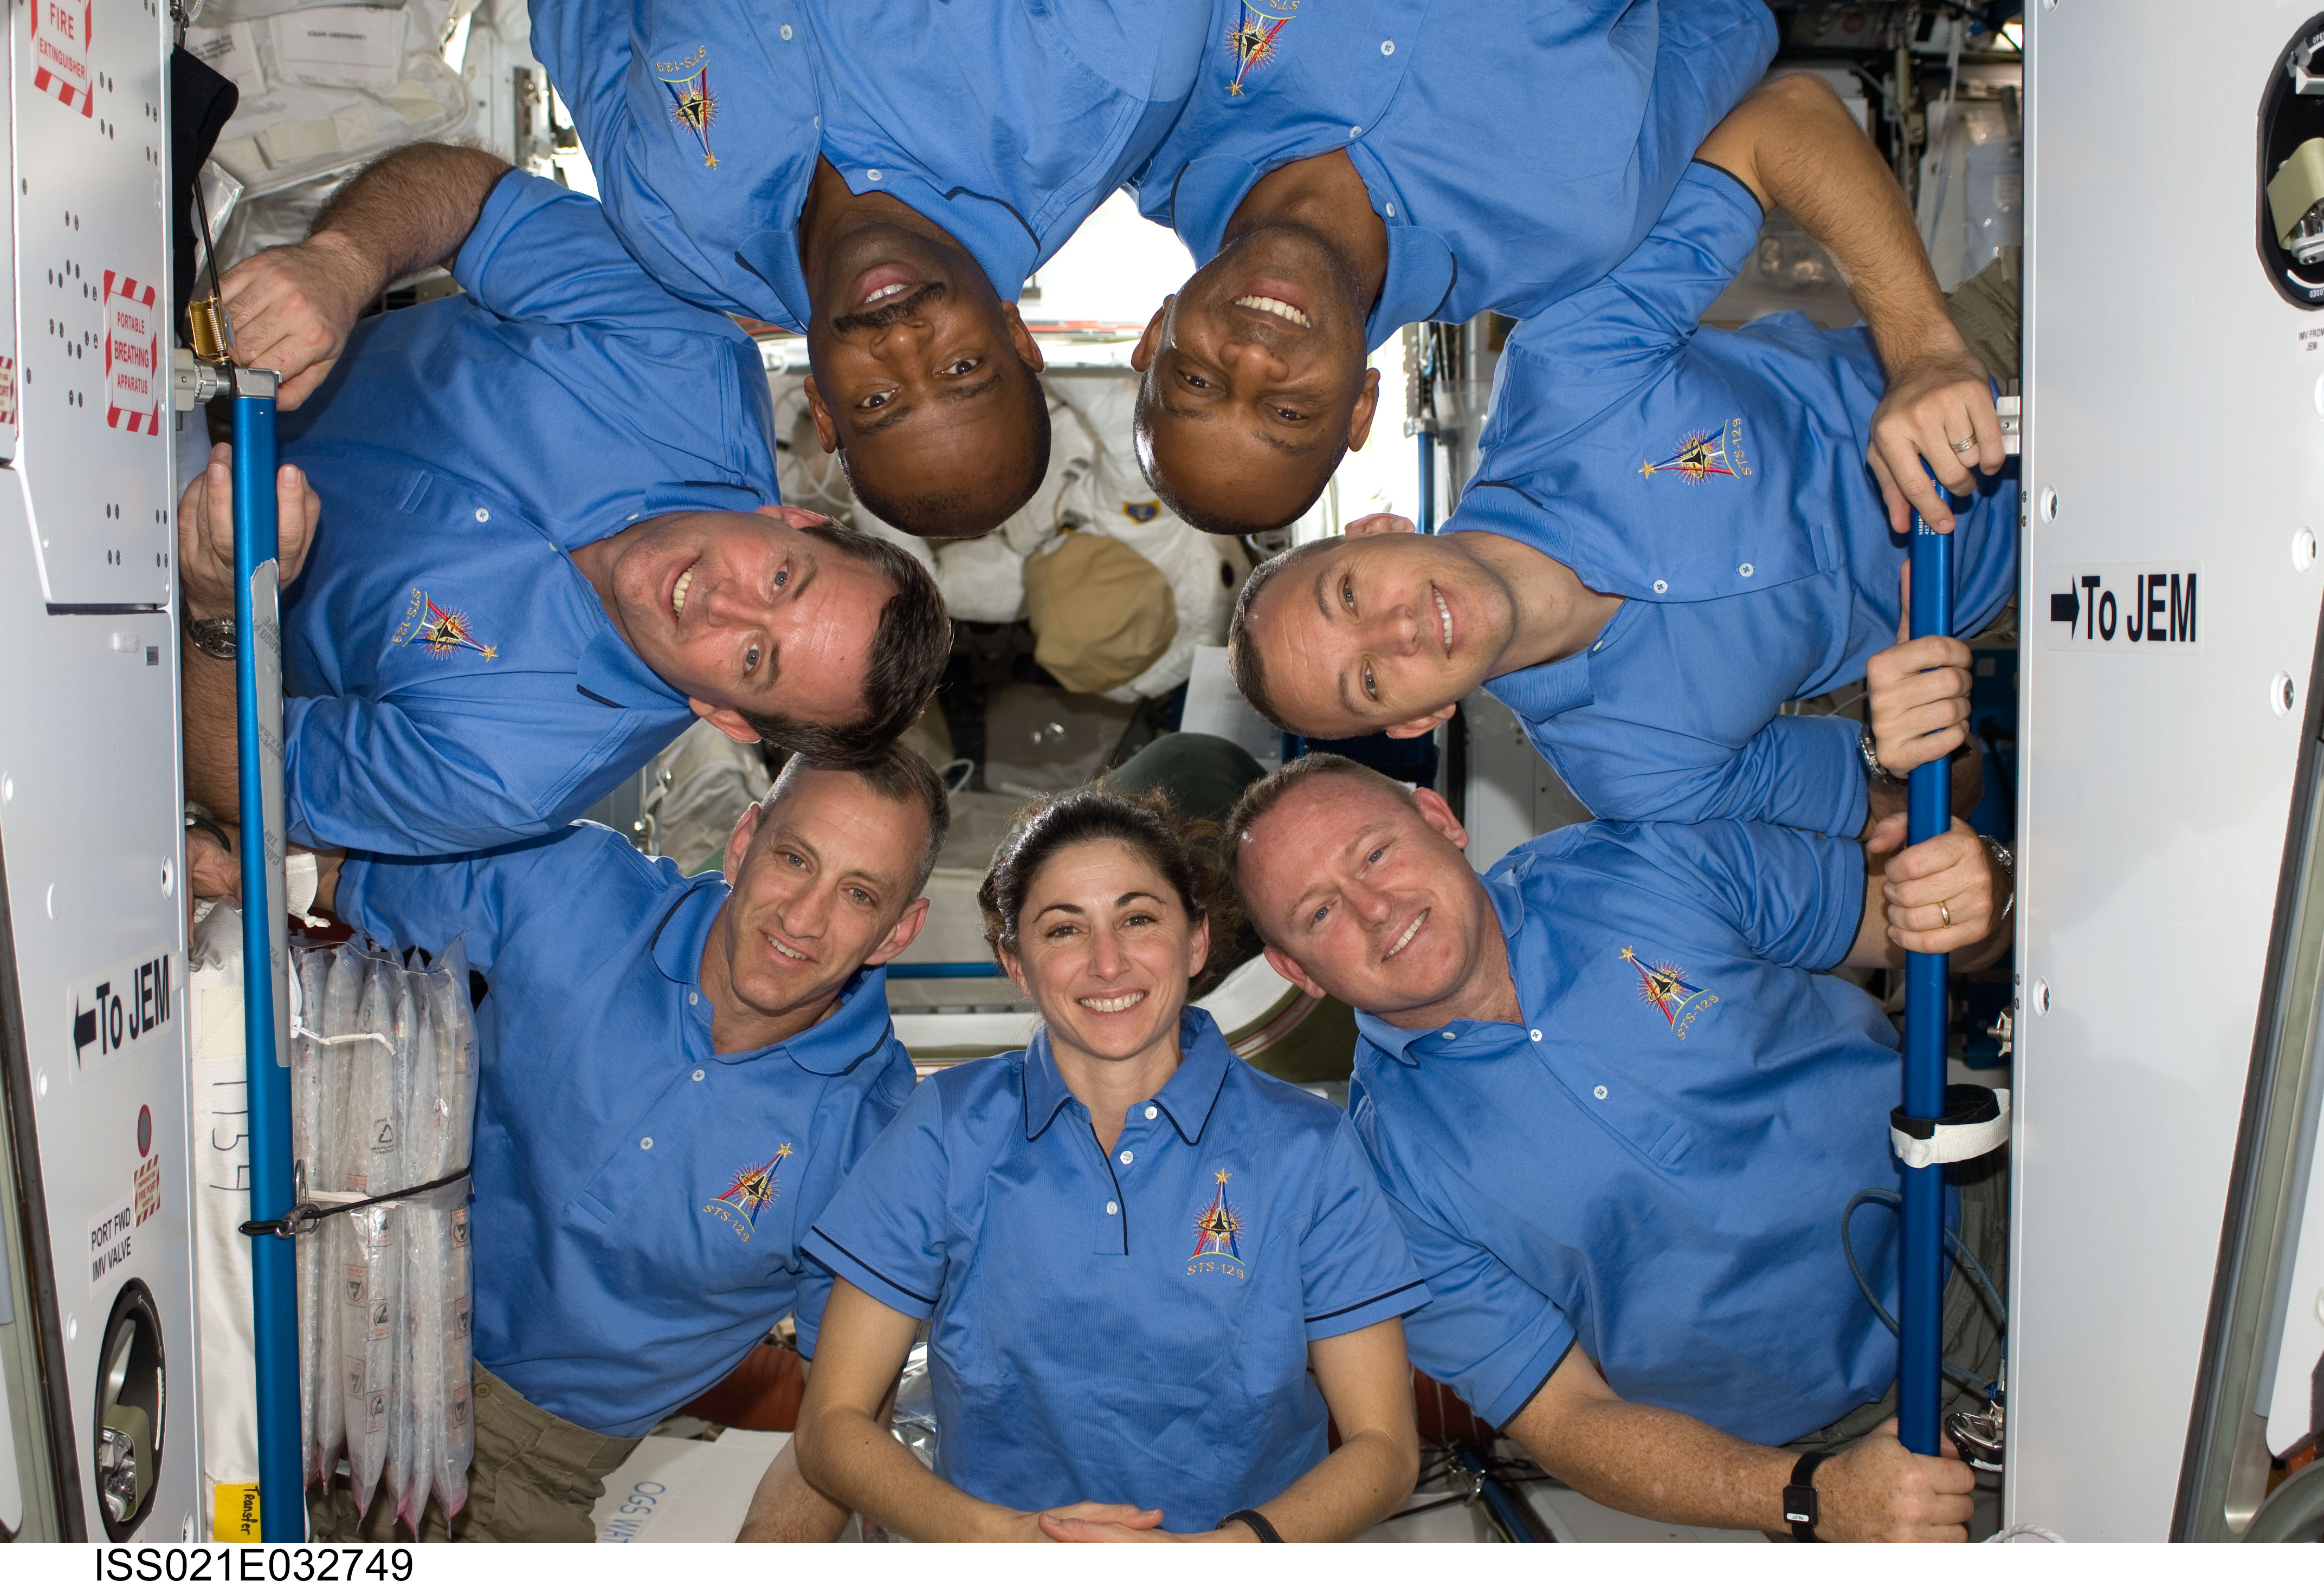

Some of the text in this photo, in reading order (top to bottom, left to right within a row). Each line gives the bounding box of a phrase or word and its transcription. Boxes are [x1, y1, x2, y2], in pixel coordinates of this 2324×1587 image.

[50, 2, 74, 41] FIRE
[2313, 32, 2324, 44] OPE
[40, 37, 86, 81] EXTINGUISHER
[656, 45, 706, 72] STS-129
[118, 312, 145, 334] PORTABLE
[2299, 331, 2308, 340] IMV
[114, 340, 149, 368] BREATHING
[2306, 341, 2317, 351] JEM
[0, 384, 9, 397] ORT
[117, 373, 148, 394] APPARATUS
[1731, 418, 1752, 476] STS-129
[392, 587, 421, 643] STS-129
[2081, 573, 2197, 642] To JEM
[96, 954, 170, 1055] To JEM
[1677, 995, 1719, 1040] STS-129
[138, 1188, 146, 1203] FIRE
[147, 1180, 156, 1195] PORT
[92, 1207, 131, 1252] PORT FWD
[703, 1204, 750, 1242] STS-129
[93, 1236, 131, 1282] IMV VALVE
[1187, 1261, 1244, 1279] STS-129
[619, 1481, 666, 1515] OGS
